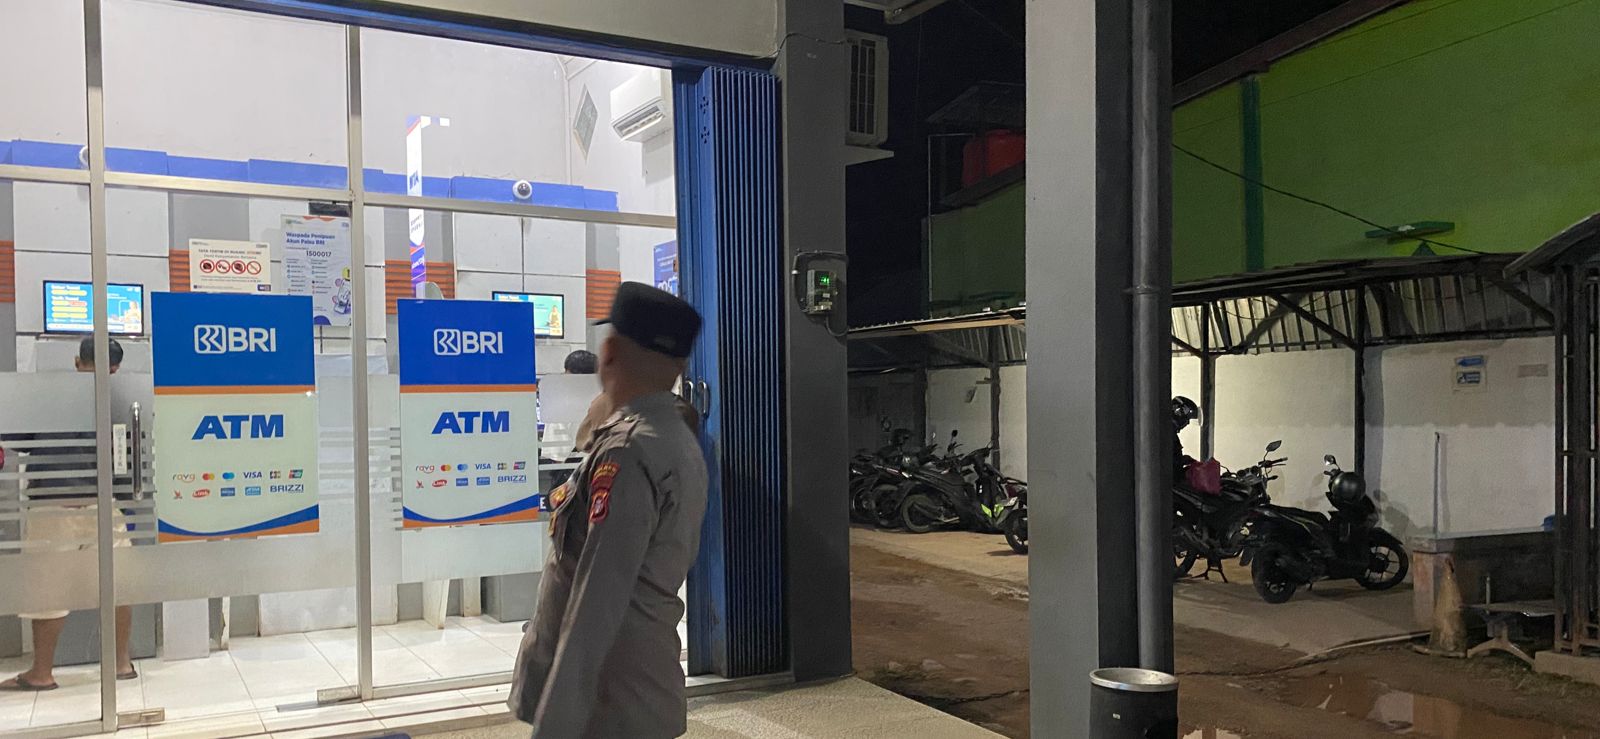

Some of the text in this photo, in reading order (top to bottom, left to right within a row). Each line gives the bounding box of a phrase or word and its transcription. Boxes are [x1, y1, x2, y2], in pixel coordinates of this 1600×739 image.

[228, 326, 277, 353] BRI
[462, 331, 504, 355] BRI
[192, 414, 284, 441] ATM
[431, 411, 510, 435] ATM
[243, 471, 263, 479] VISA
[497, 475, 527, 483] BRIZZI
[269, 484, 305, 493] BRIZZI
